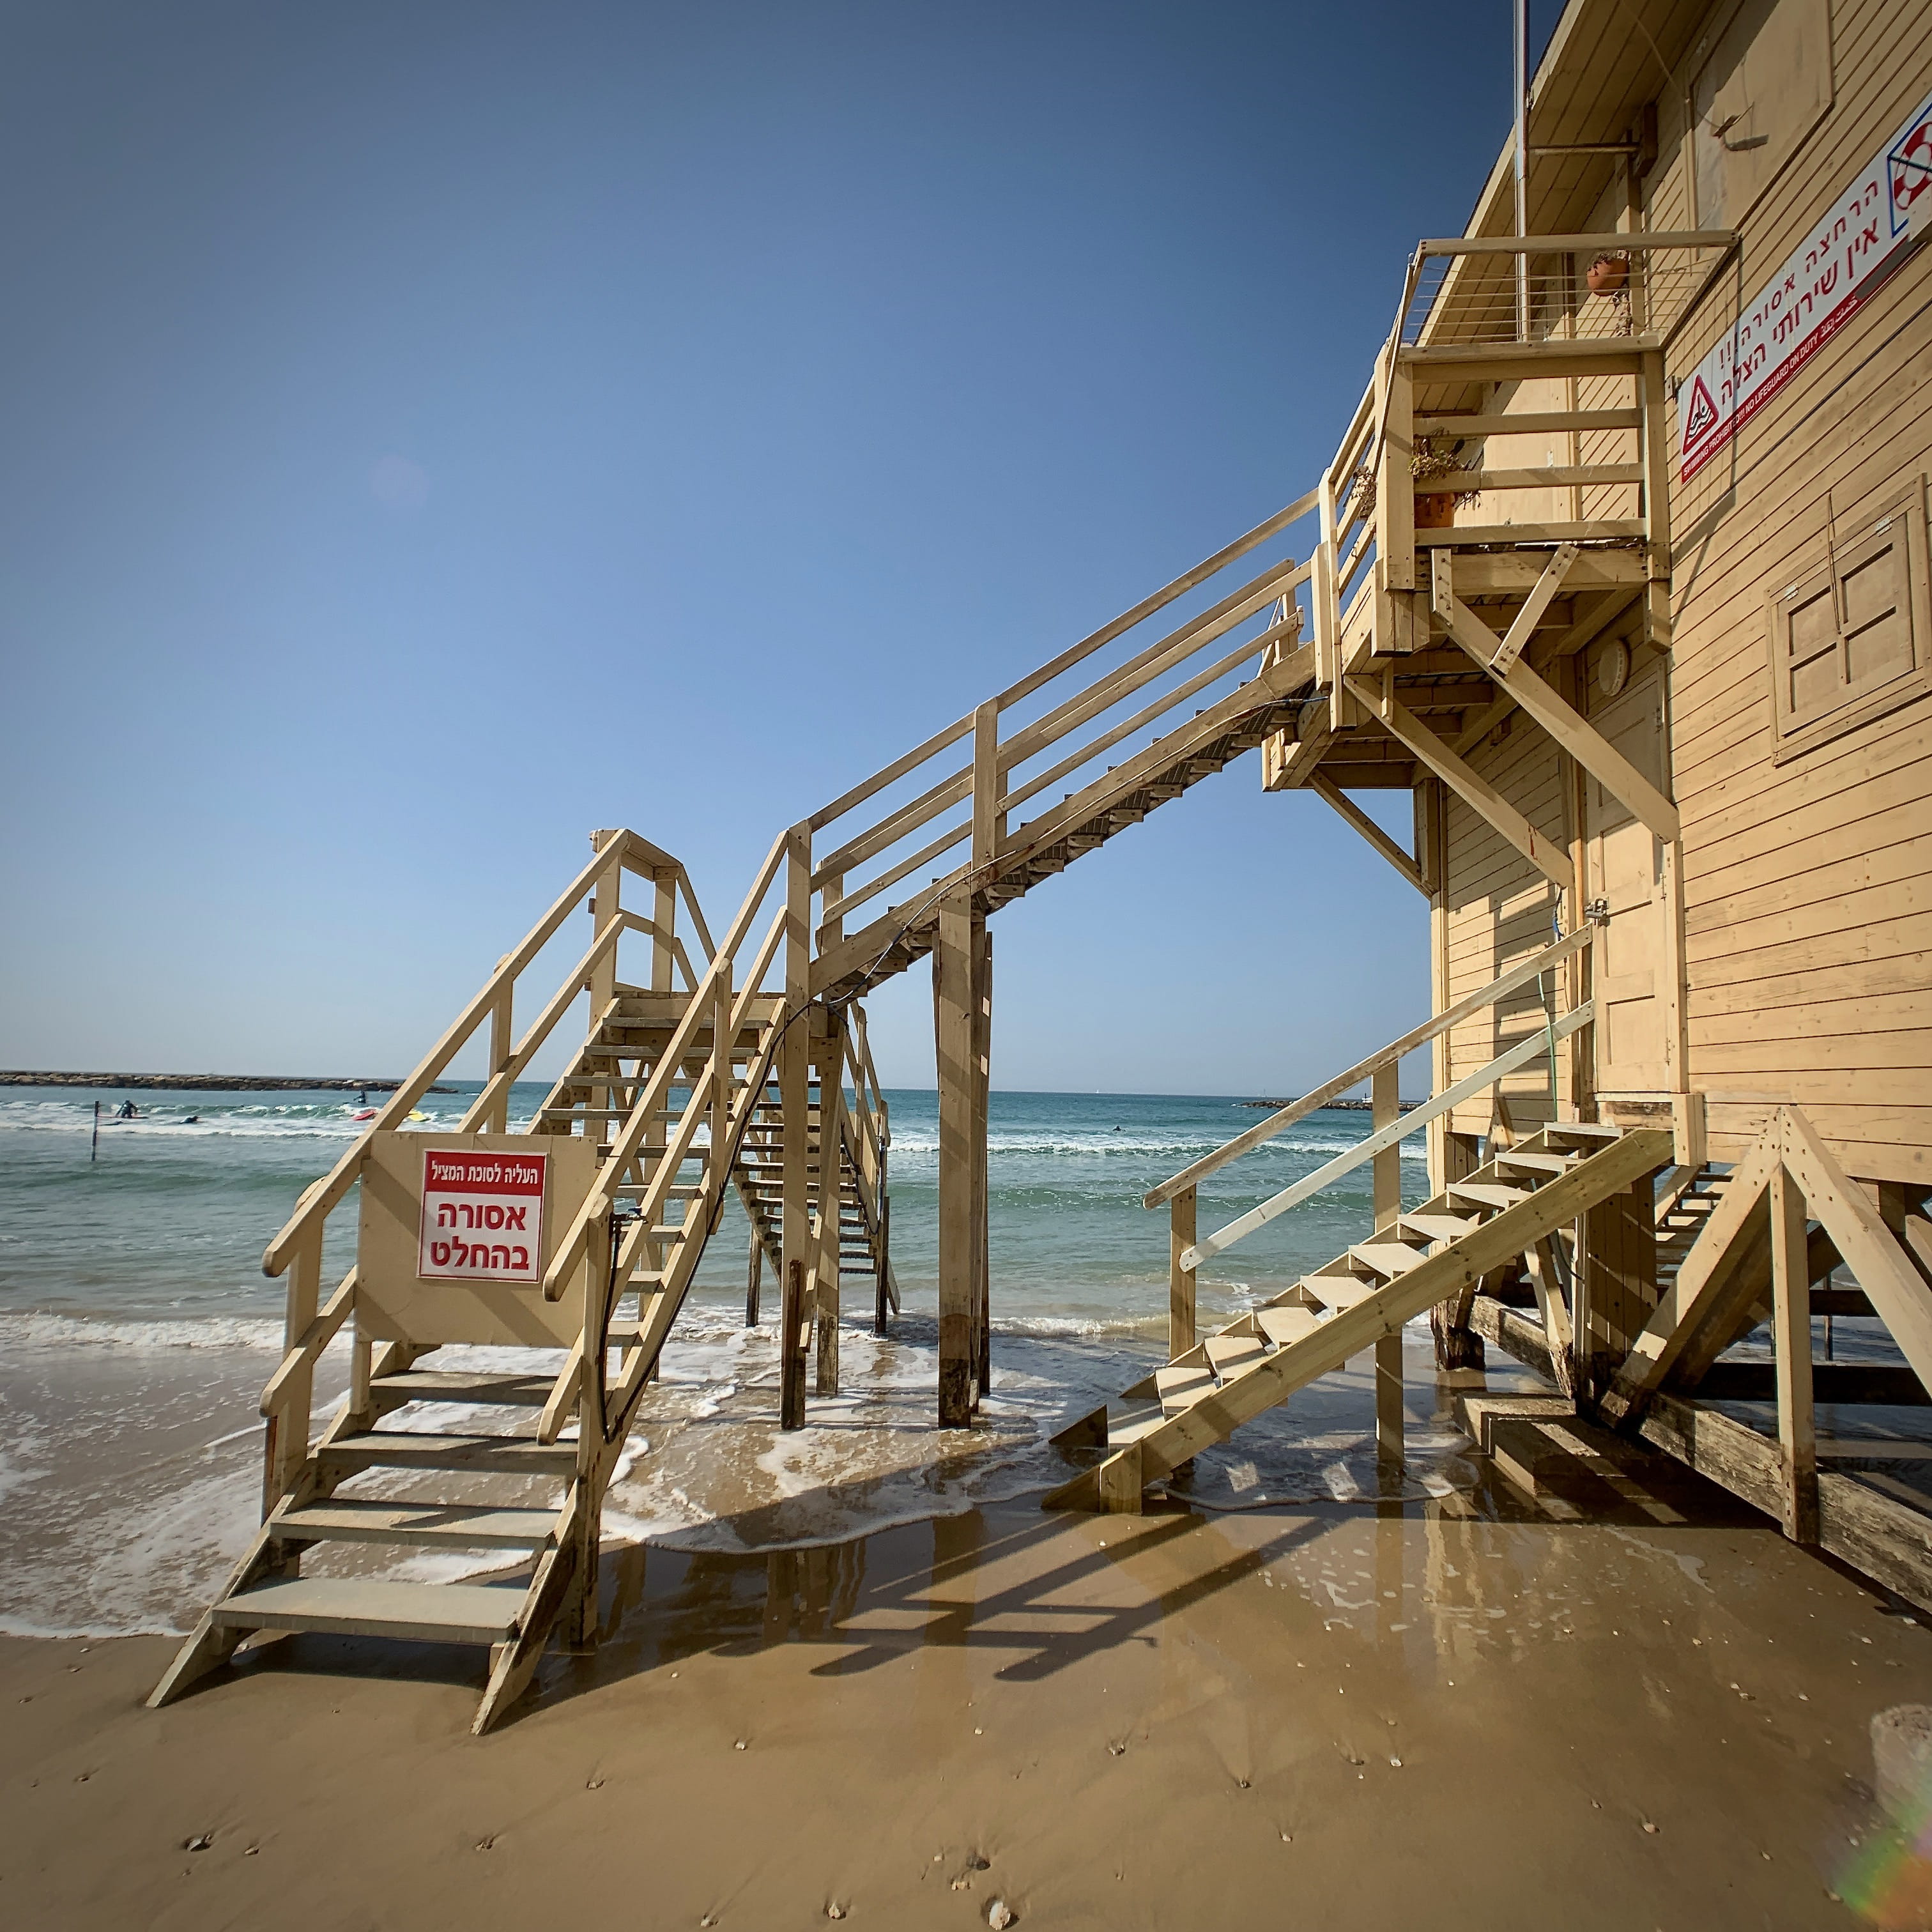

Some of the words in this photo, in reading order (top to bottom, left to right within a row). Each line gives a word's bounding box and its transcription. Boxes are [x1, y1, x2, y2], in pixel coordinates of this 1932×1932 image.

[1805, 180, 1878, 273] הרחצה
[1846, 217, 1880, 279] אין
[1772, 259, 1839, 344] שירותי
[1721, 342, 1767, 405] הצלה
[1683, 445, 1709, 476] SWIMMING
[1745, 399, 1754, 414] NO
[1754, 365, 1789, 404] LIFEGUARD
[1790, 353, 1800, 369] ON
[1800, 333, 1818, 359] DUTY
[431, 1160, 464, 1182] המציל
[467, 1162, 502, 1183] לסוכת
[503, 1163, 538, 1184] העליה
[437, 1202, 526, 1231] אסורה
[429, 1236, 530, 1271] בהחלט
